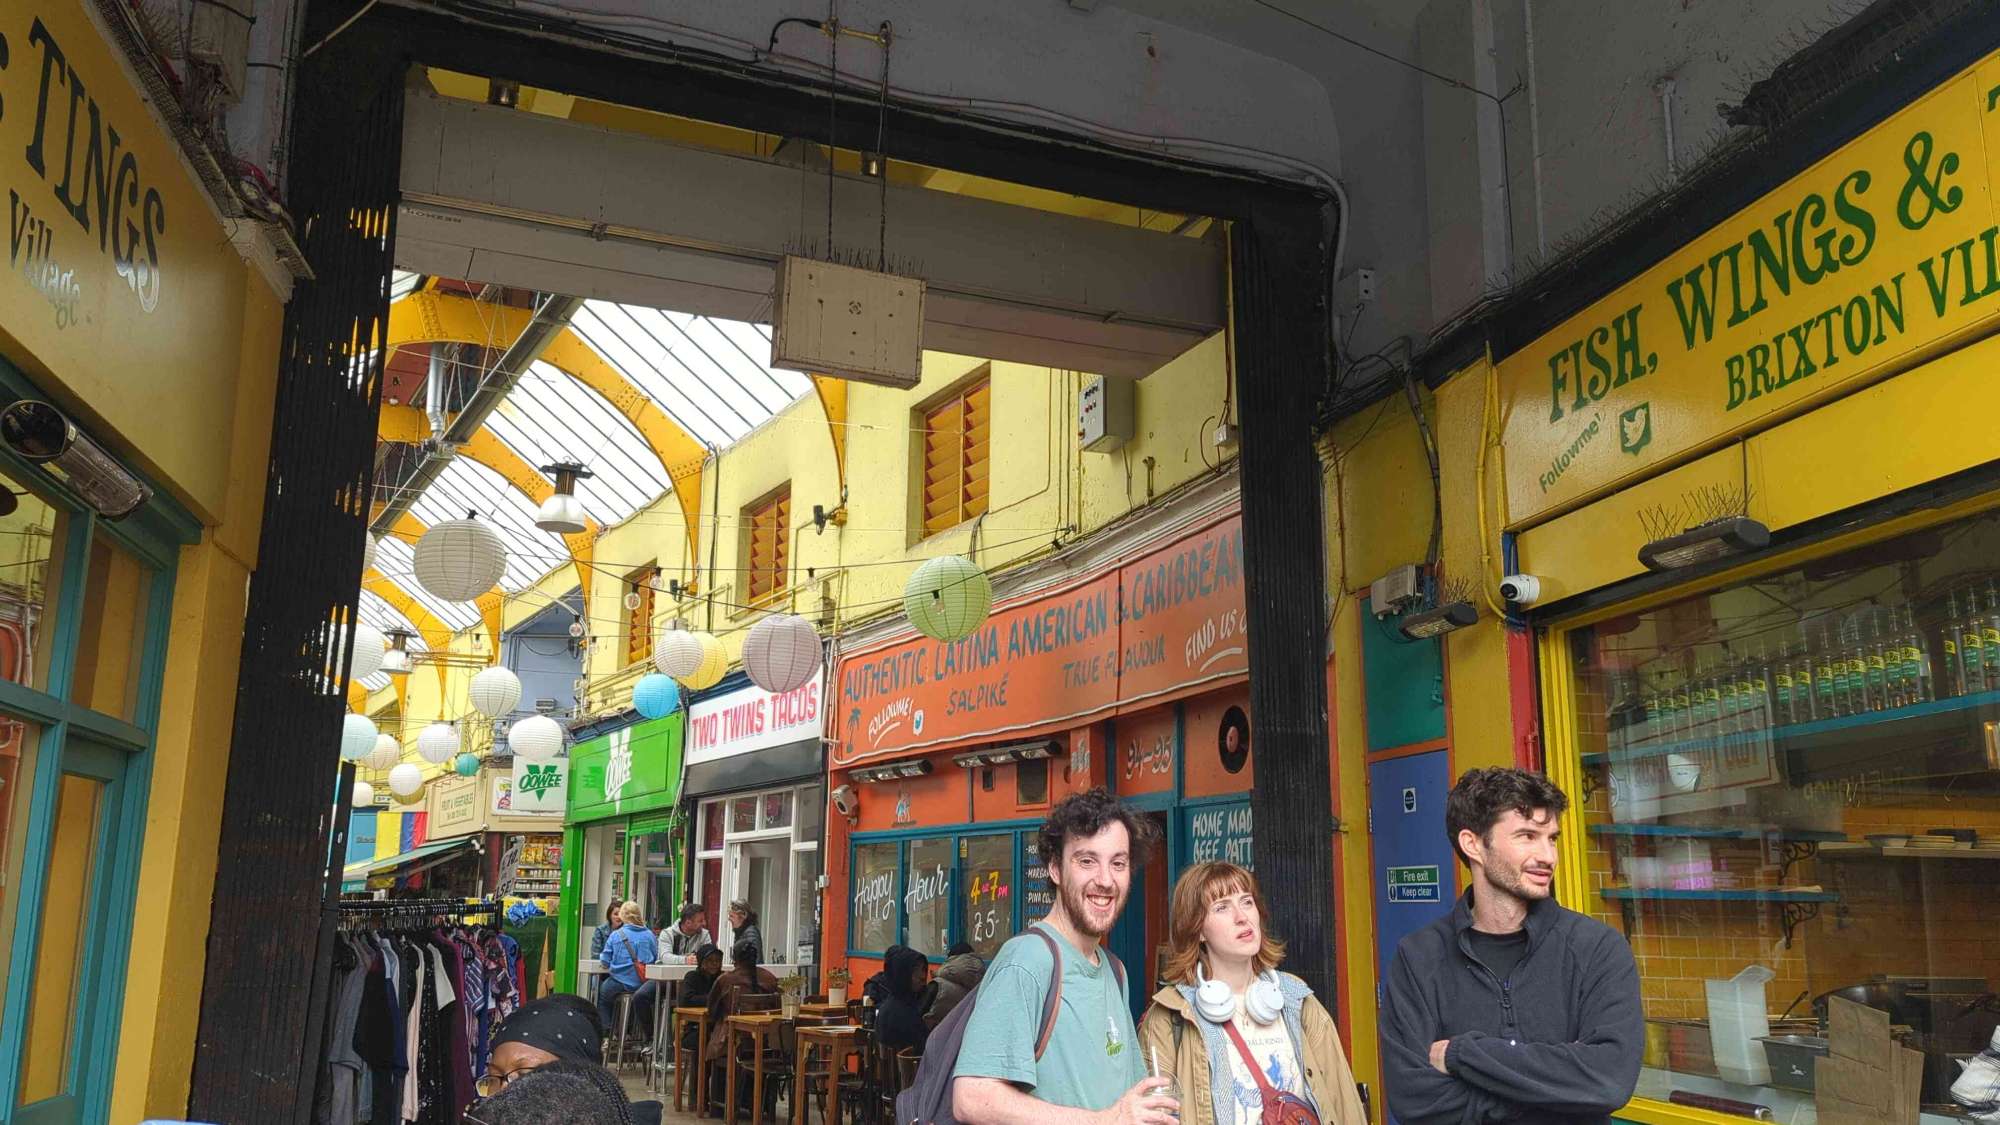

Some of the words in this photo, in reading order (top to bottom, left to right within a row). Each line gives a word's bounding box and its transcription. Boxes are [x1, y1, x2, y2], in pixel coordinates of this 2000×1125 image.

[26, 16, 165, 313] TINGS
[1549, 304, 1658, 424] FISH,
[1666, 170, 1876, 351] WINGS
[1897, 131, 1964, 230] &
[1725, 273, 1905, 411] BRIXTON
[844, 647, 927, 704] AUTHENTIC
[935, 624, 999, 681] LATINA
[1008, 591, 1107, 661] AMERICAN
[1185, 617, 1216, 668] FIND
[1220, 608, 1238, 640] US
[947, 671, 1008, 716] SALPIKÉ
[1064, 655, 1101, 689] TRUE
[692, 712, 718, 750] TWO
[722, 698, 766, 745] TWINS
[771, 682, 818, 730] TACOS
[519, 773, 563, 793] OOWEE
[1192, 810, 1225, 838] HOME
[1224, 836, 1254, 864] PATT
[854, 870, 896, 920] Happy
[904, 863, 949, 914] Hour
[1402, 886, 1417, 899] Keep
[1417, 886, 1432, 897] clear
[1403, 870, 1415, 882] Fire
[1416, 870, 1429, 881] exit
